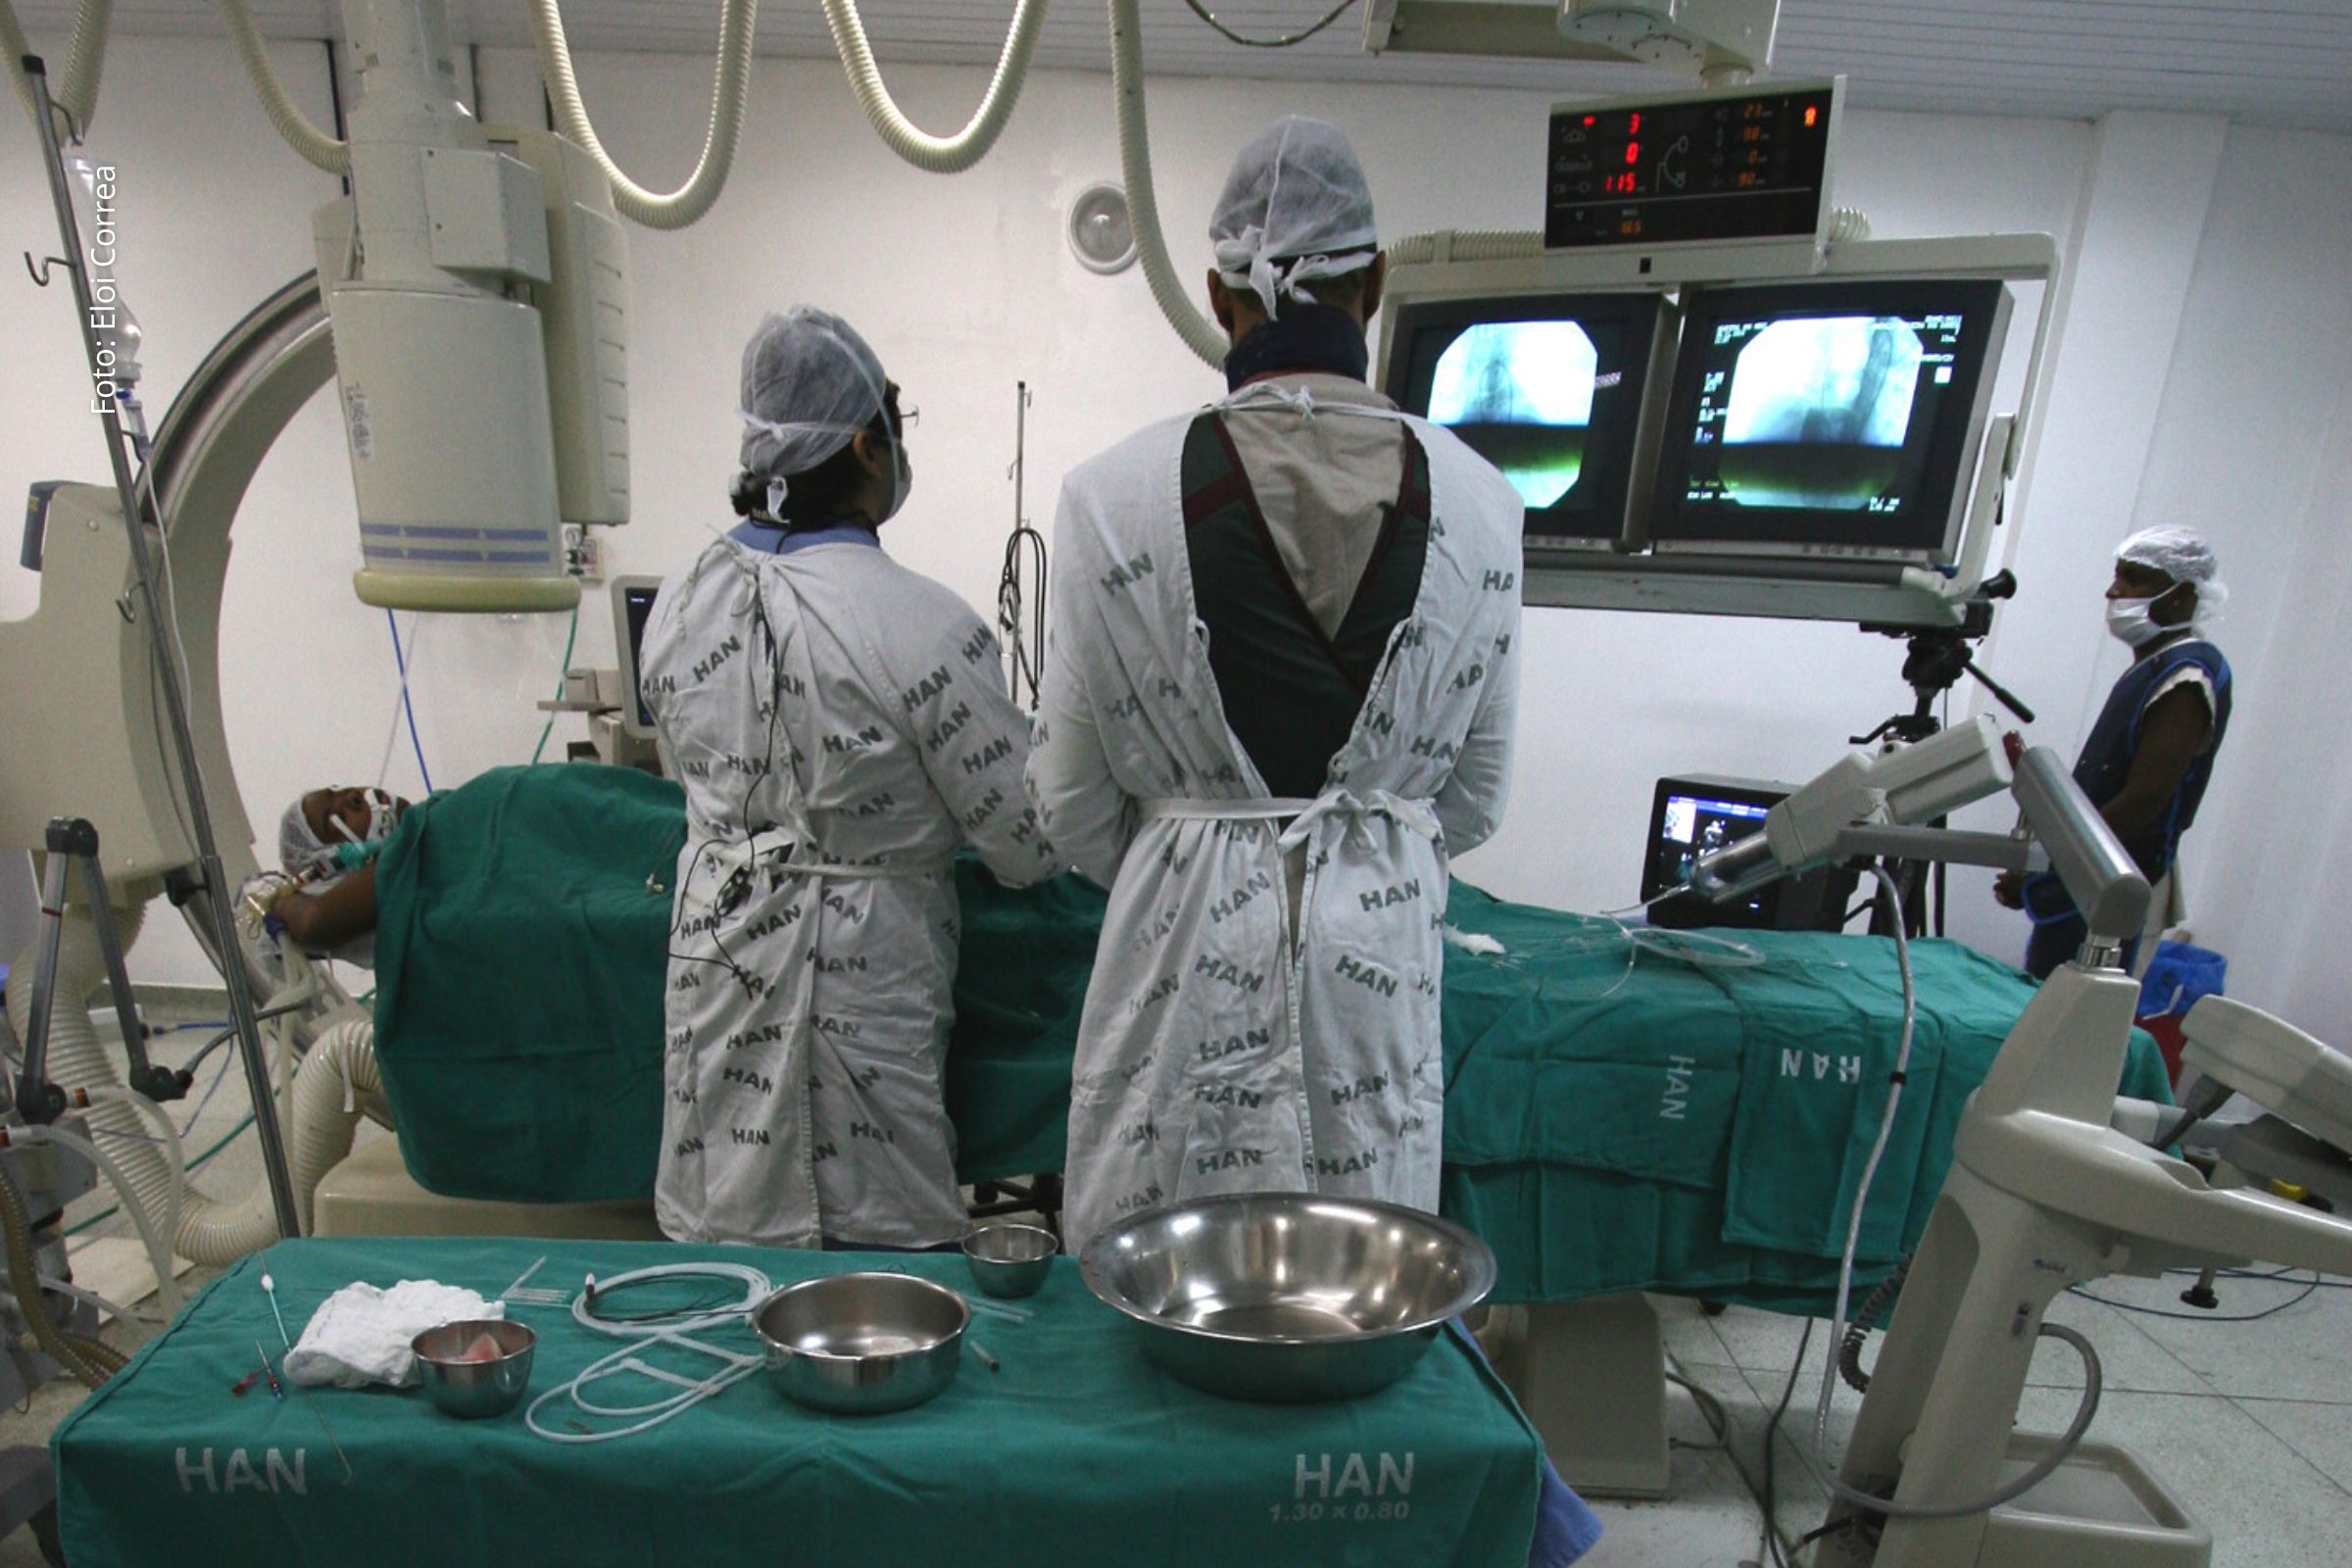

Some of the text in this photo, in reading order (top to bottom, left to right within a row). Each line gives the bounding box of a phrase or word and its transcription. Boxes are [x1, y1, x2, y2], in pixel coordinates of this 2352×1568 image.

[1483, 569, 1515, 591] HA
[693, 634, 742, 683] HAN
[902, 664, 953, 712] HAN
[1104, 694, 1143, 718] HA
[822, 726, 882, 753] HAN
[926, 701, 971, 752] HAN
[962, 735, 1013, 774] HAN
[1410, 737, 1461, 763] HA
[682, 760, 710, 778] AN
[964, 787, 1004, 831] HAN
[1010, 807, 1037, 844] HA
[1209, 872, 1271, 923] HAN
[1358, 879, 1420, 912] HAN
[680, 915, 721, 940] HAN
[747, 904, 802, 941] HAN
[1195, 954, 1264, 994] HAN
[1334, 954, 1397, 999] HAN
[726, 1025, 782, 1051] HAN
[1199, 1028, 1270, 1060] HAN
[723, 1067, 774, 1097] HAN
[1781, 1048, 1861, 1084] HAN
[1330, 1070, 1389, 1106] HAN
[1659, 1054, 1695, 1119] HAN
[674, 1137, 705, 1158] AN
[731, 1129, 770, 1146] HAN
[1197, 1149, 1264, 1175] HAN
[1318, 1147, 1378, 1175] HAN
[1115, 1184, 1164, 1212] HAN
[175, 1446, 308, 1495] HAN
[1294, 1451, 1415, 1499] HAN
